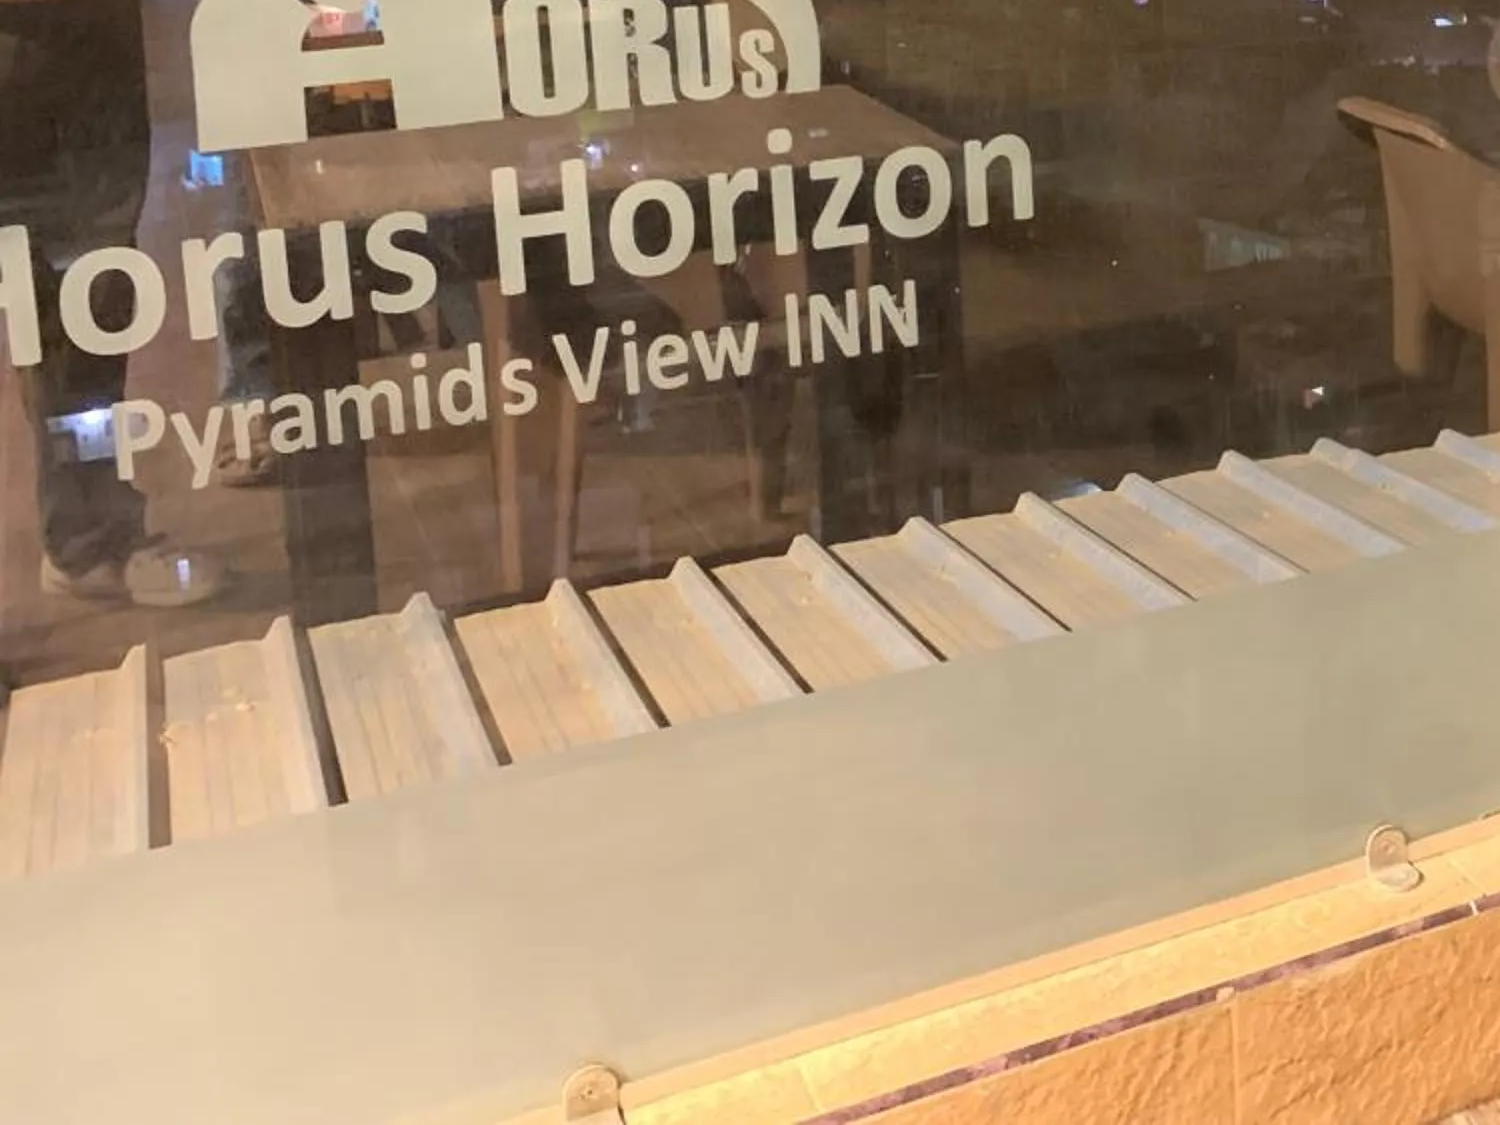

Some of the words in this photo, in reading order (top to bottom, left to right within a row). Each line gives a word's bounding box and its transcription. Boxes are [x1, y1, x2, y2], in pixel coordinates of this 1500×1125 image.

[491, 129, 1034, 295] Horizon
[111, 342, 538, 490] Pyramids
[551, 321, 760, 404] View
[785, 279, 919, 368] INN
